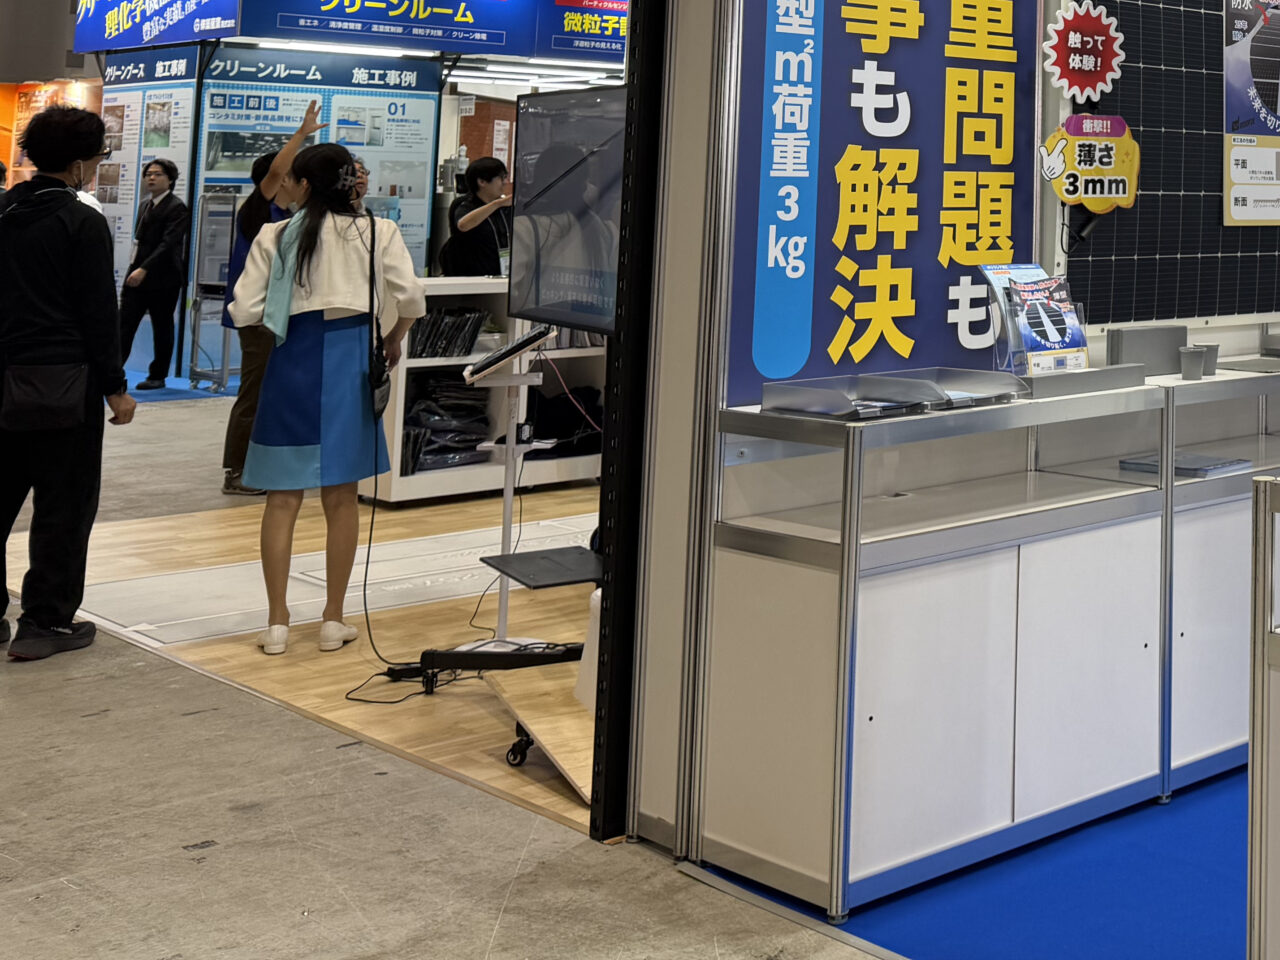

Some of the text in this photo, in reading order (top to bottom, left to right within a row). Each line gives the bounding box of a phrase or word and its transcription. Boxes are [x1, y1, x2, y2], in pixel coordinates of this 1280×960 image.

[1067, 30, 1106, 51] 触って
[155, 58, 187, 78] 施工事例
[209, 59, 418, 87] クリーンルーム 施工事例
[387, 102, 407, 116] 01
[1076, 141, 1116, 170] 薄さ
[1233, 158, 1248, 169] 平面
[1063, 171, 1128, 198] 3mm
[1233, 196, 1248, 207] 断面
